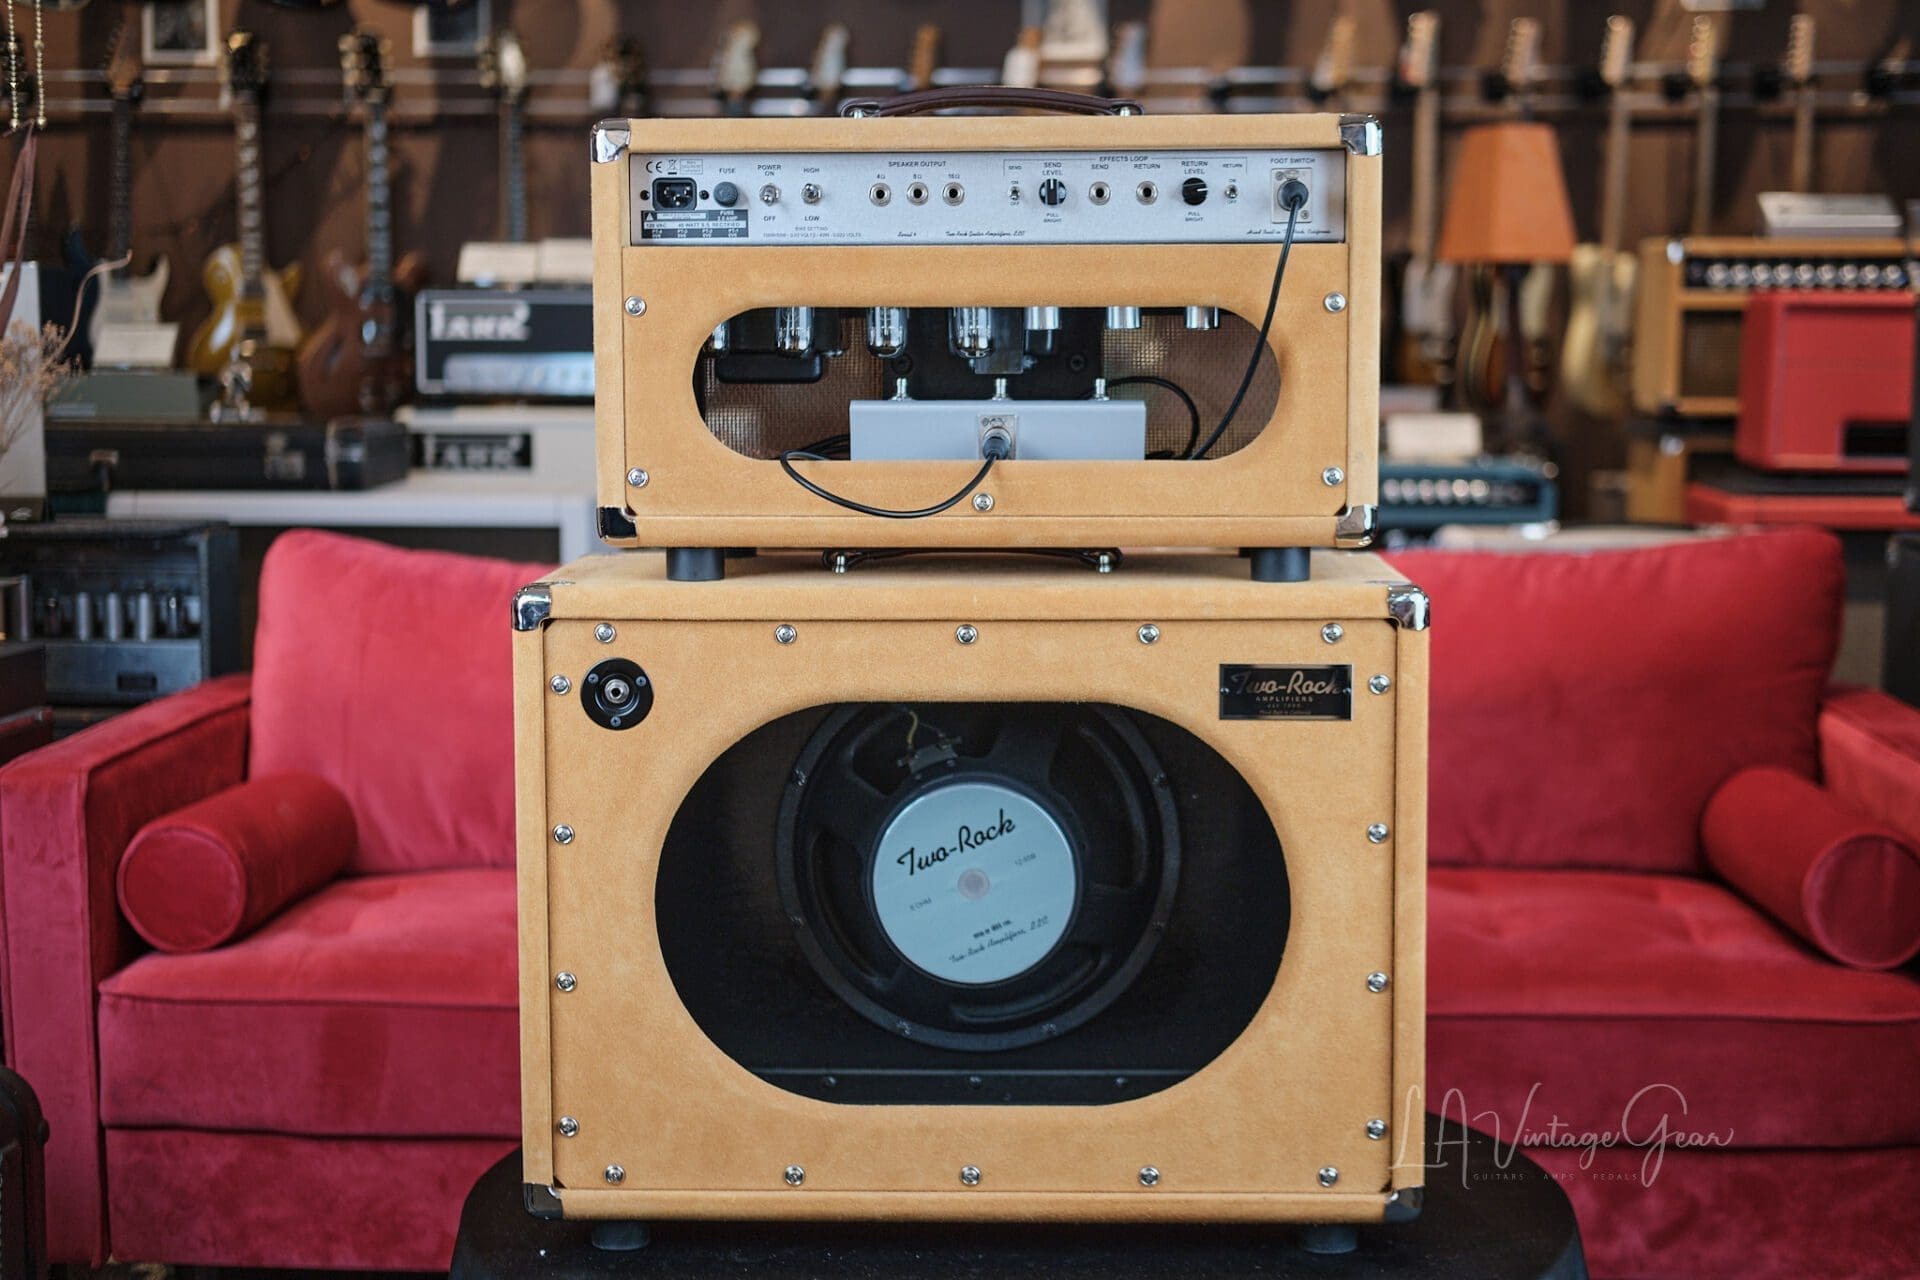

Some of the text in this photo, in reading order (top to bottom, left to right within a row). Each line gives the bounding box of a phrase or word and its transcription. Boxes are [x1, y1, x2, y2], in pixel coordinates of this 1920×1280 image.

[888, 160, 947, 168] SPEAKER OUTPUT
[1231, 670, 1341, 695] Two-Rock
[897, 808, 1016, 876] Two-Rock
